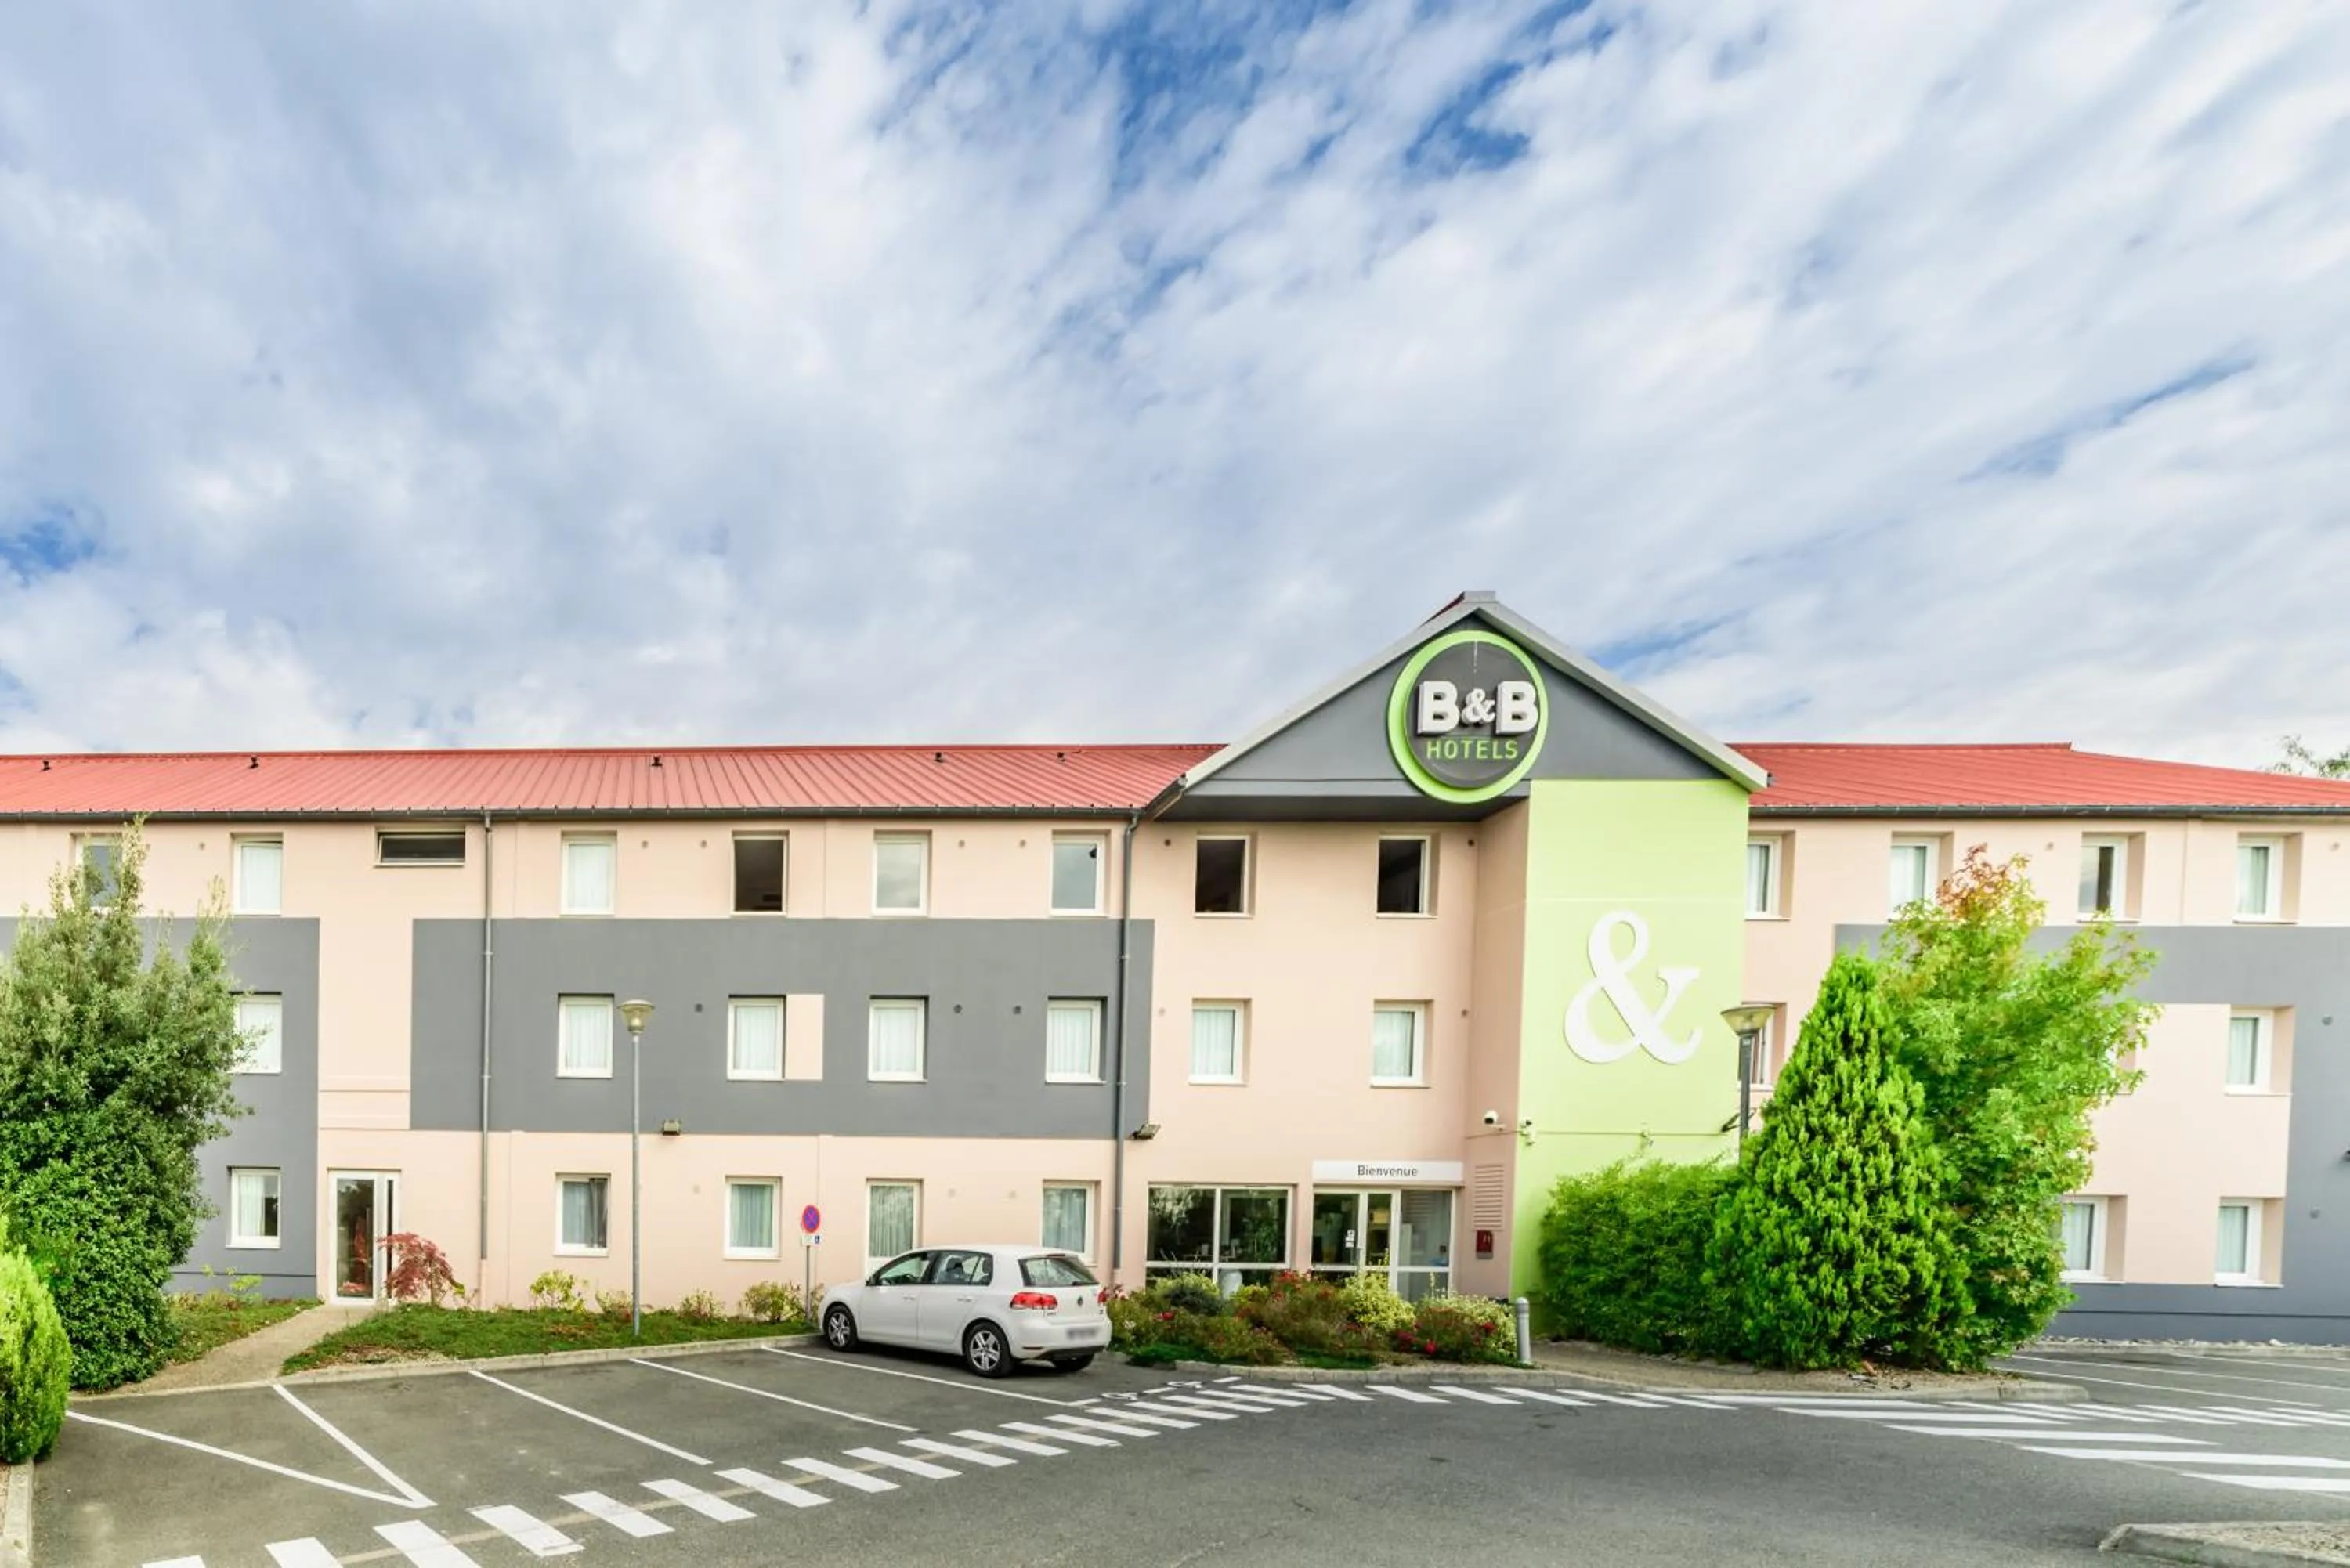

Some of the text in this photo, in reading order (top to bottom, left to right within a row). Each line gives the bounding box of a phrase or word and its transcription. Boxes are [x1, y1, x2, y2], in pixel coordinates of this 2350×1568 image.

[1417, 681, 1538, 735] B&B
[1426, 741, 1517, 759] HOTELS
[1563, 910, 1704, 1065] &
[1358, 1165, 1418, 1176] Bienvenue
